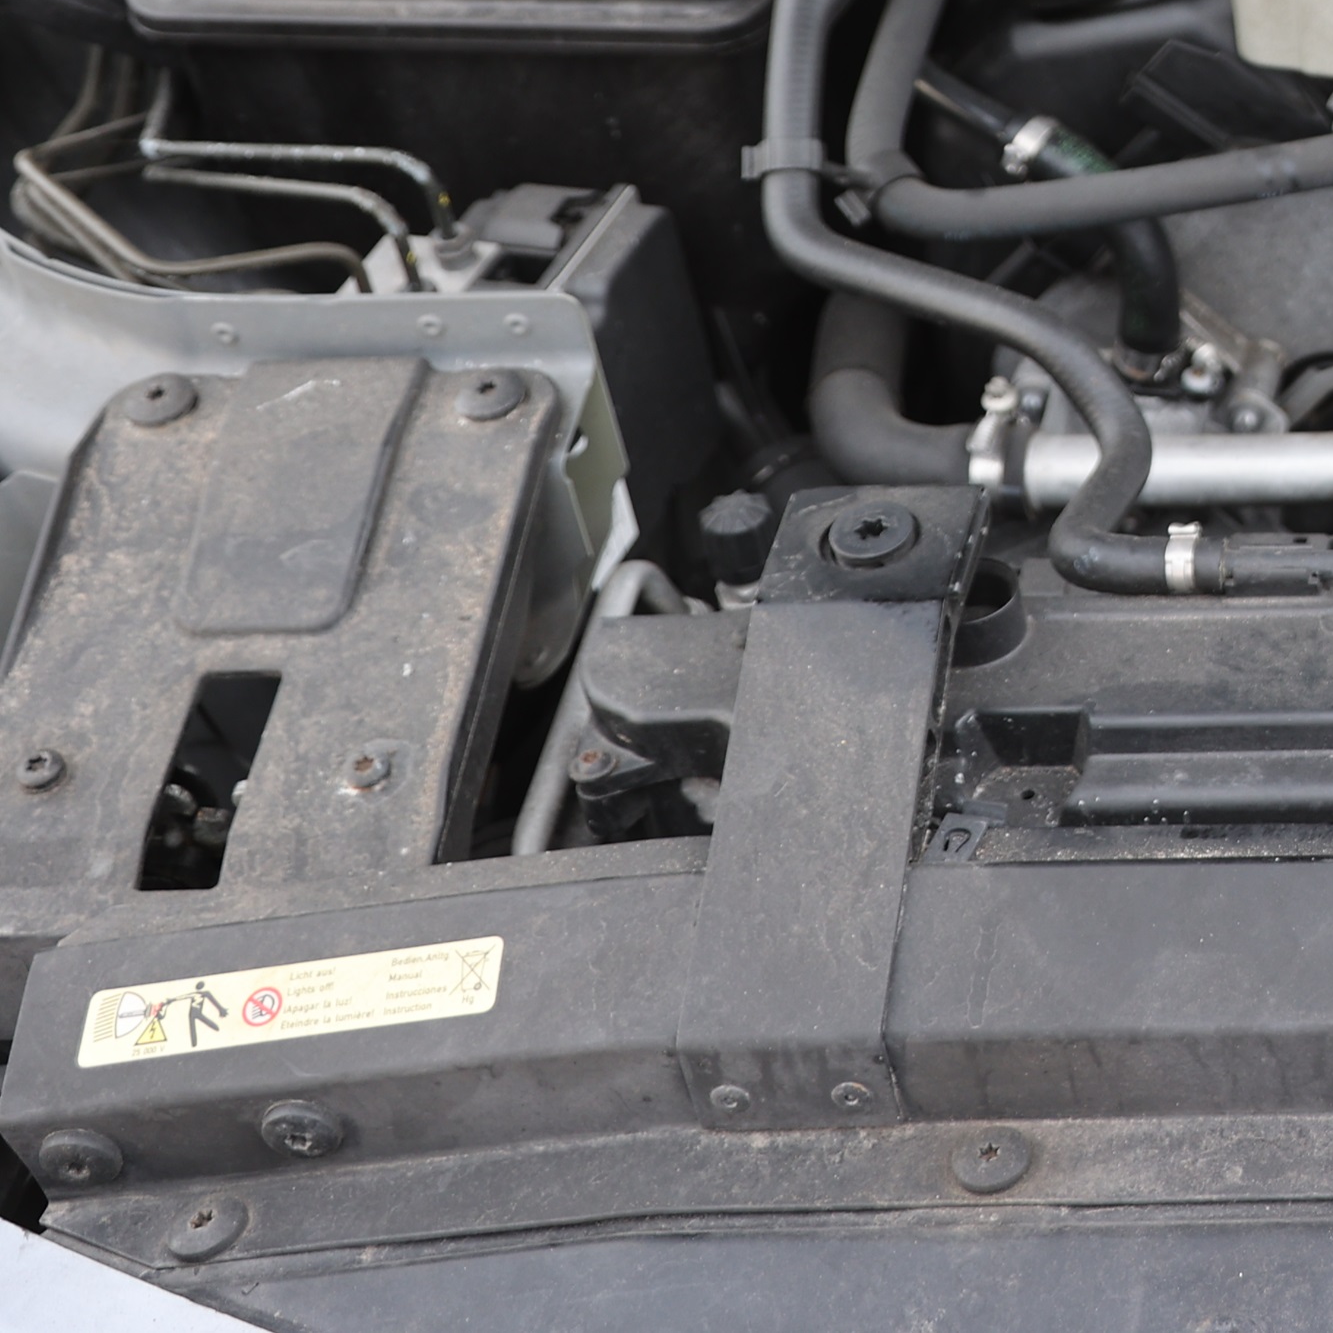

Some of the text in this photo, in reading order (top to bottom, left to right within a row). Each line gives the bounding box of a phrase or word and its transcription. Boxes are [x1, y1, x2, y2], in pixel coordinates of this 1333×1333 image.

[290, 967, 336, 980] Licht aus!
[389, 970, 422, 981] Manual
[287, 985, 315, 997] Lights
[386, 985, 447, 1000] Instrucciones
[462, 996, 474, 1004] Hg
[383, 1002, 432, 1015] Instruction
[280, 1016, 319, 1030] Eteindre
[323, 1015, 331, 1023] la
